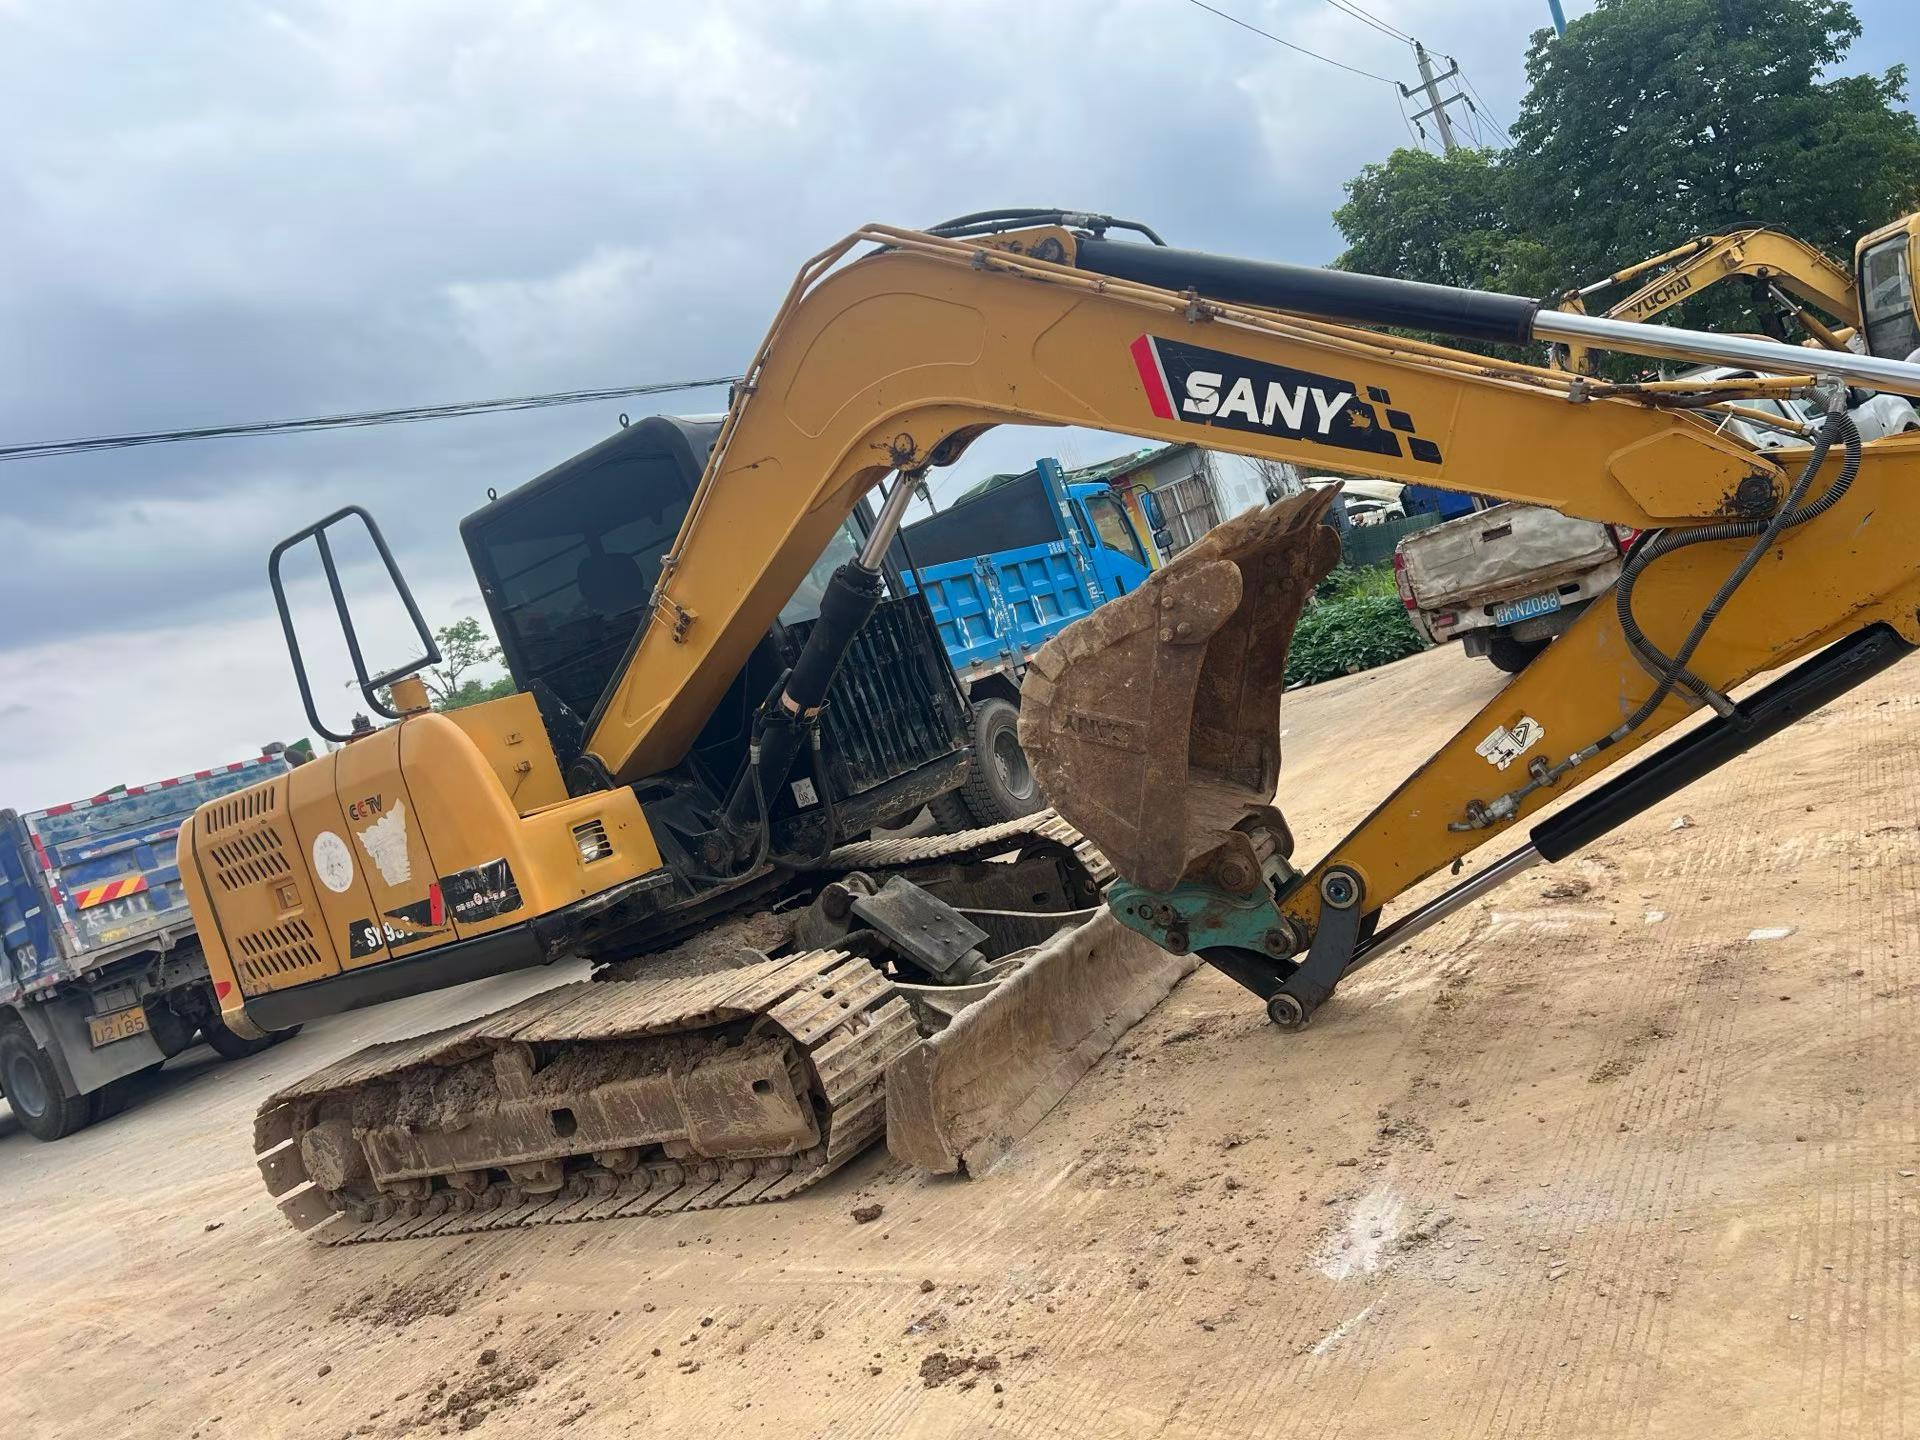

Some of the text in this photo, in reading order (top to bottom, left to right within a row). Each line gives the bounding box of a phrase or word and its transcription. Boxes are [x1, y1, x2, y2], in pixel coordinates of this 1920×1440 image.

[1630, 275, 1691, 318] YUCHAI
[1183, 370, 1353, 434] SANY
[349, 794, 382, 821] CCTV
